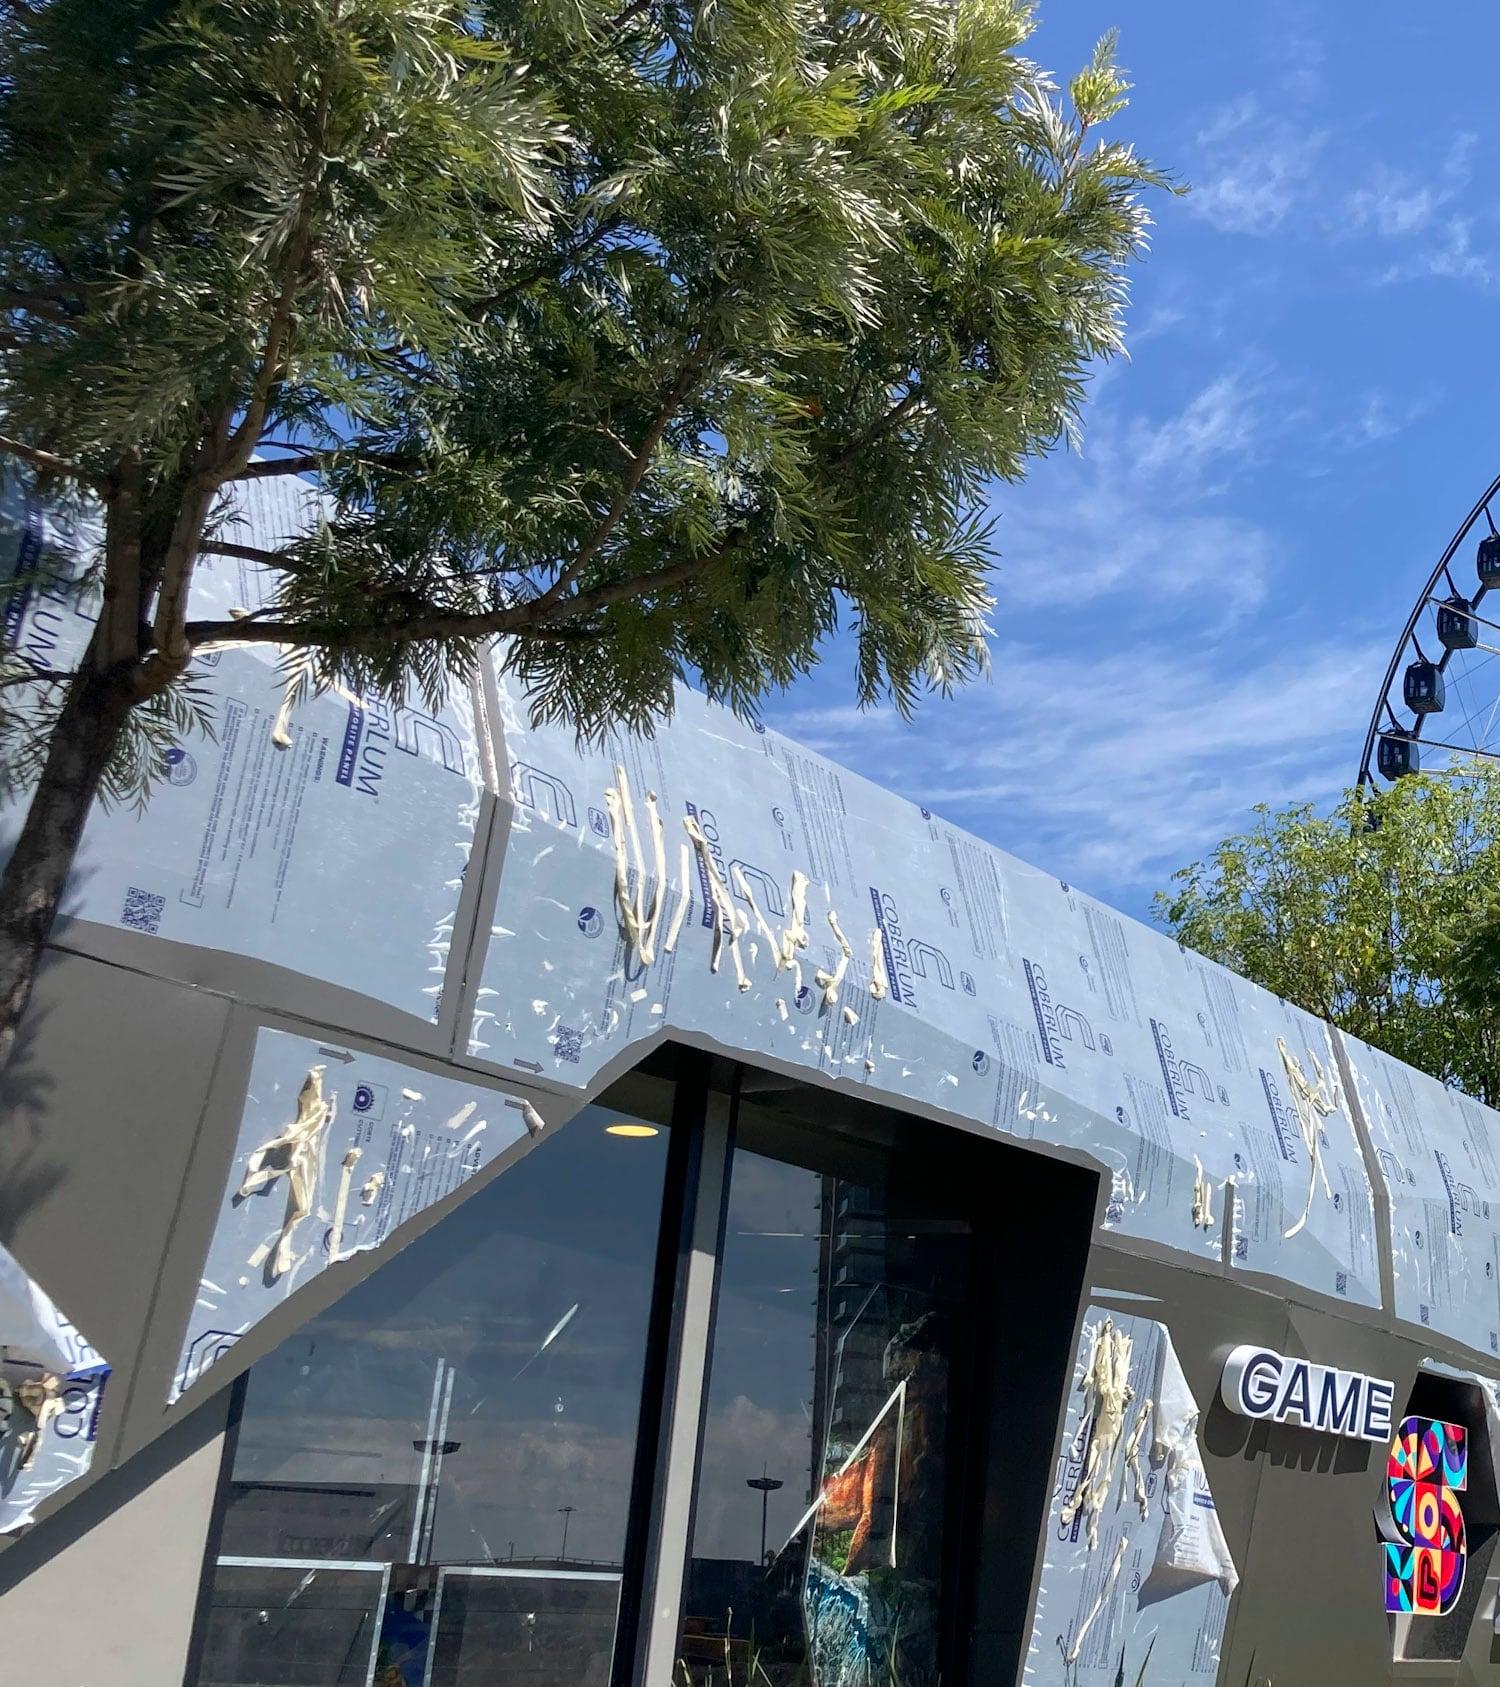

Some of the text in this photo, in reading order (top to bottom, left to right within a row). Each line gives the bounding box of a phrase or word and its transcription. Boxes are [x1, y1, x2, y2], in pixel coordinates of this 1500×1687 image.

[882, 893, 917, 1008] COBERLUM
[1033, 963, 1066, 1069] COBERLUM
[1158, 1022, 1190, 1120] COBERLUM
[1266, 1072, 1298, 1164] COBERLUM
[1240, 1351, 1394, 1443] GAME
